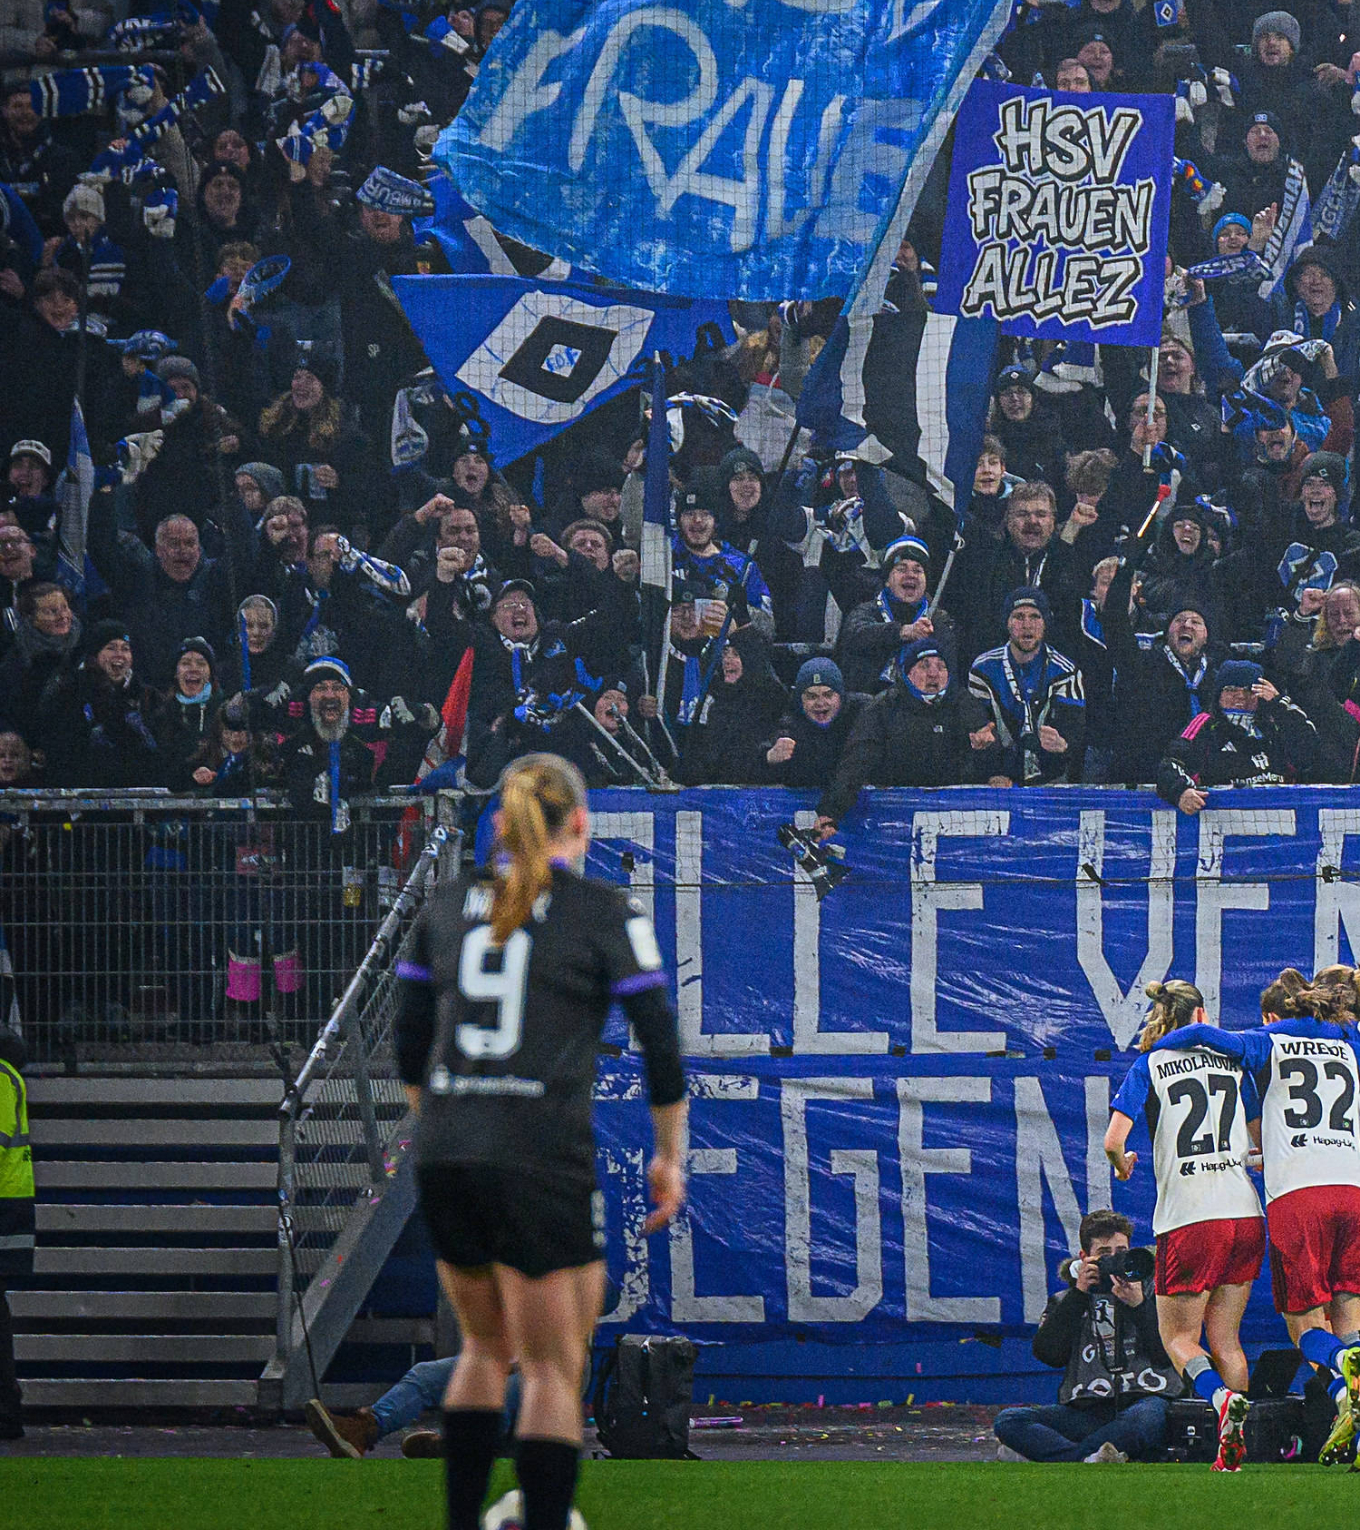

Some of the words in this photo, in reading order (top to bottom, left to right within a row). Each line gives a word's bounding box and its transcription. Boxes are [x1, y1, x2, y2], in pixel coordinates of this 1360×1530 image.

[998, 97, 1142, 183] HSV
[969, 167, 1152, 253] FRAUEN
[962, 246, 1144, 326] ALLEZ
[455, 923, 534, 1061] 9
[1280, 1041, 1349, 1061] WREDE
[1167, 1073, 1238, 1158] 27
[1279, 1058, 1356, 1137] 32
